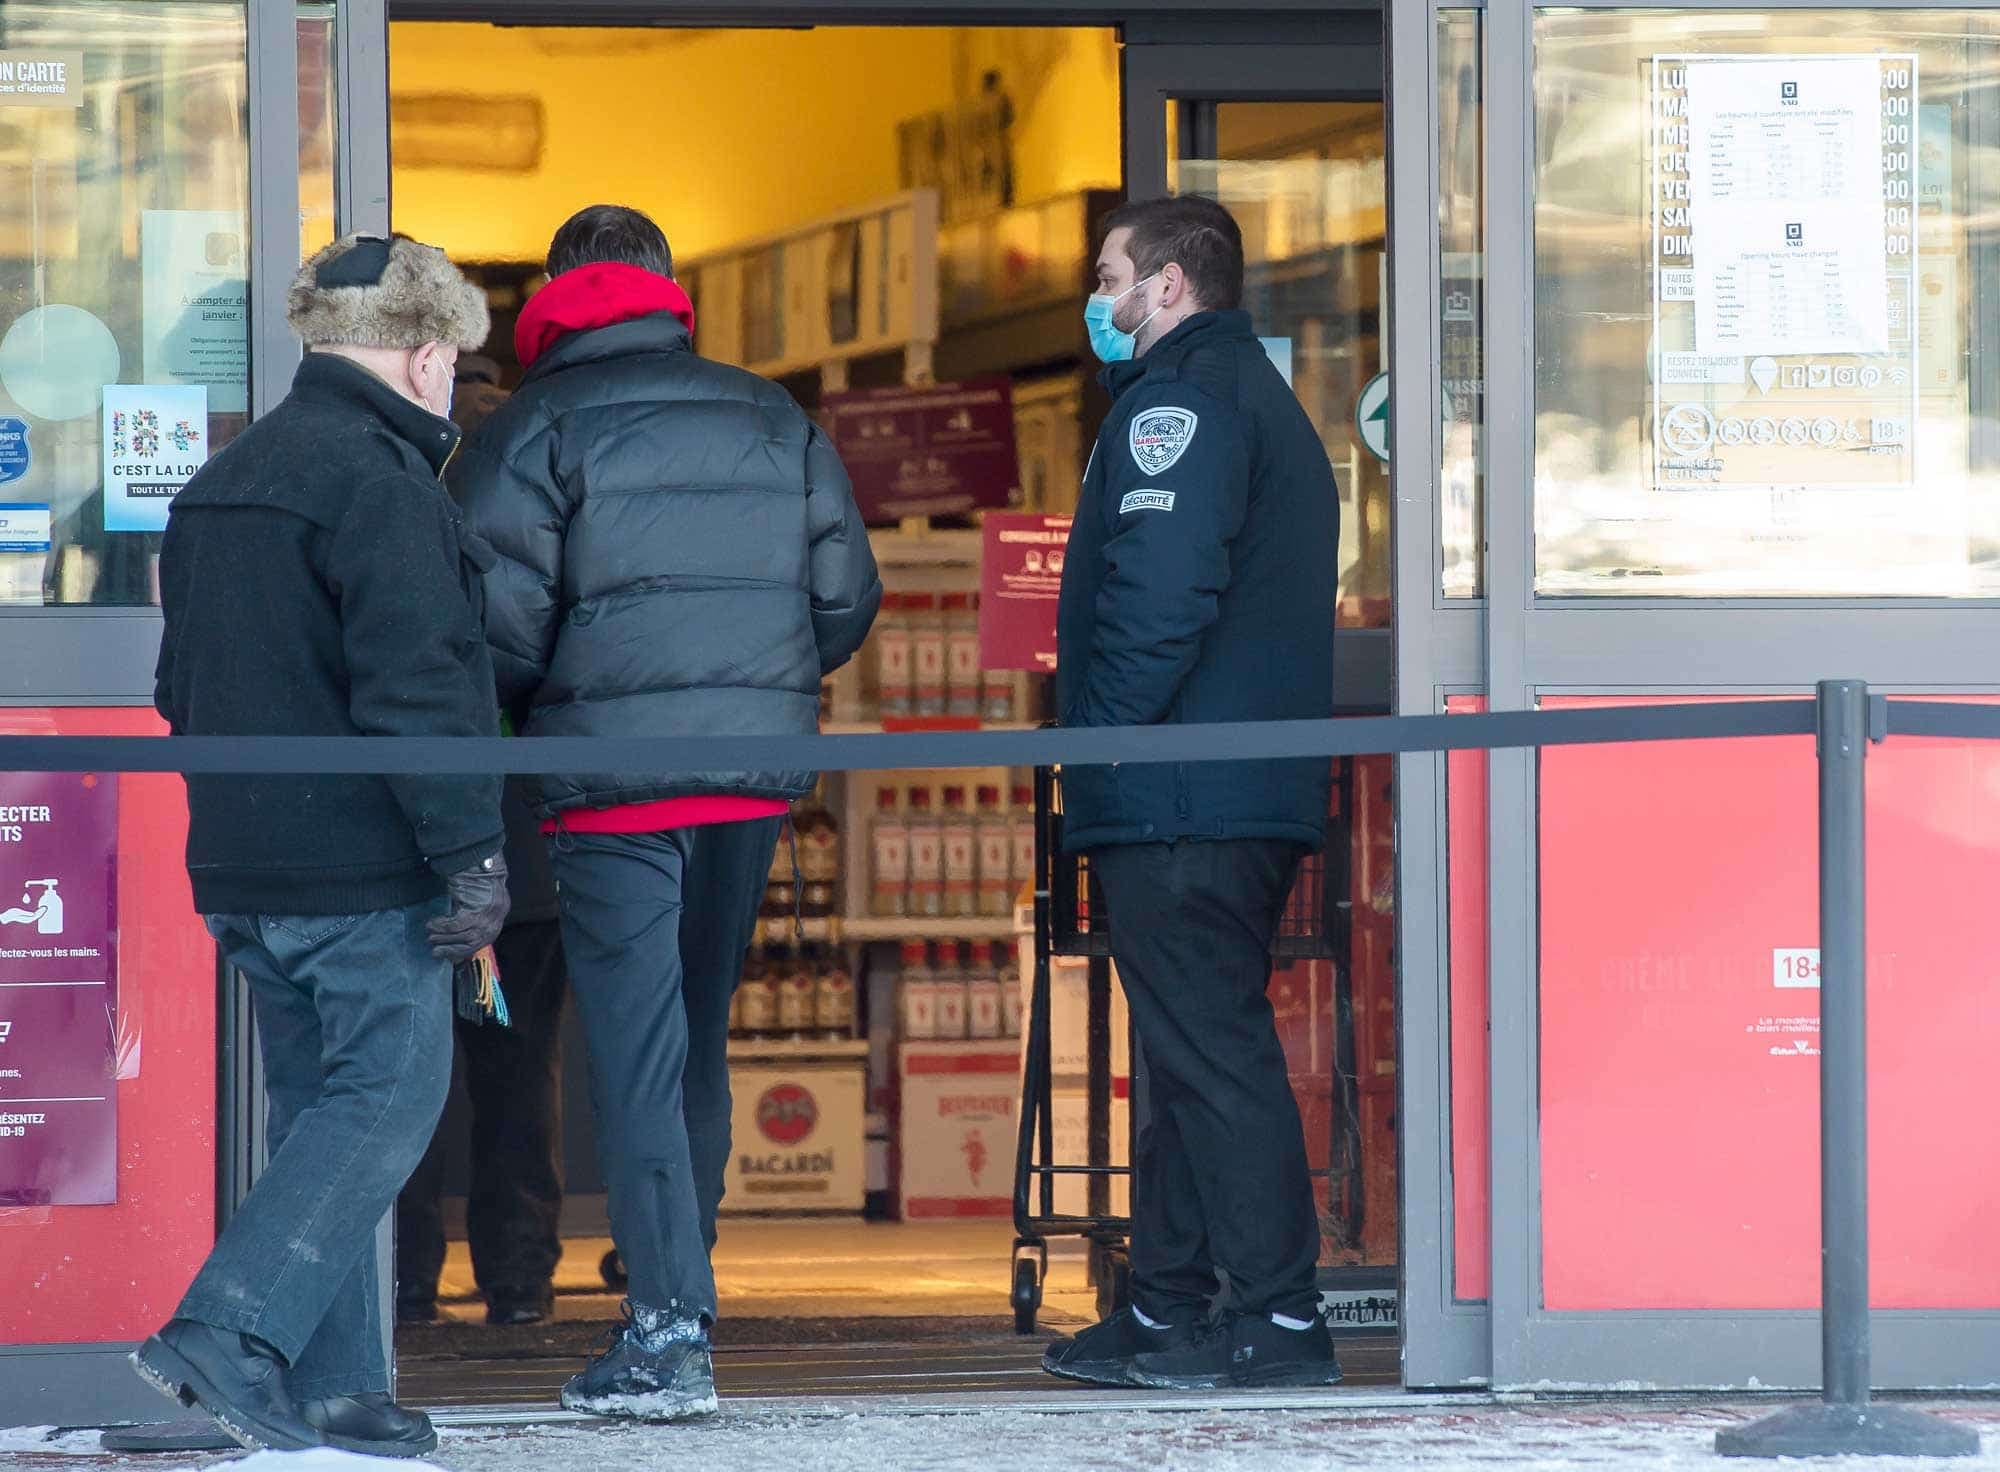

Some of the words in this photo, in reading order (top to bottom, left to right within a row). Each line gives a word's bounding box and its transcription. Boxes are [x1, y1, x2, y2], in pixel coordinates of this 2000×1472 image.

[0, 63, 14, 82] N
[17, 62, 66, 82] CARTE
[1679, 286, 1694, 296] TOU
[191, 297, 232, 305] compter
[202, 310, 236, 321] janvier
[113, 465, 152, 476] C'EST
[155, 465, 173, 476] LA
[1123, 495, 1169, 508] SÉCURITÉ
[0, 806, 51, 823] ECTER
[0, 825, 22, 842] TS
[54, 947, 68, 957] les
[70, 946, 101, 957] mains.
[0, 1112, 45, 1124] ÉSENTEZ
